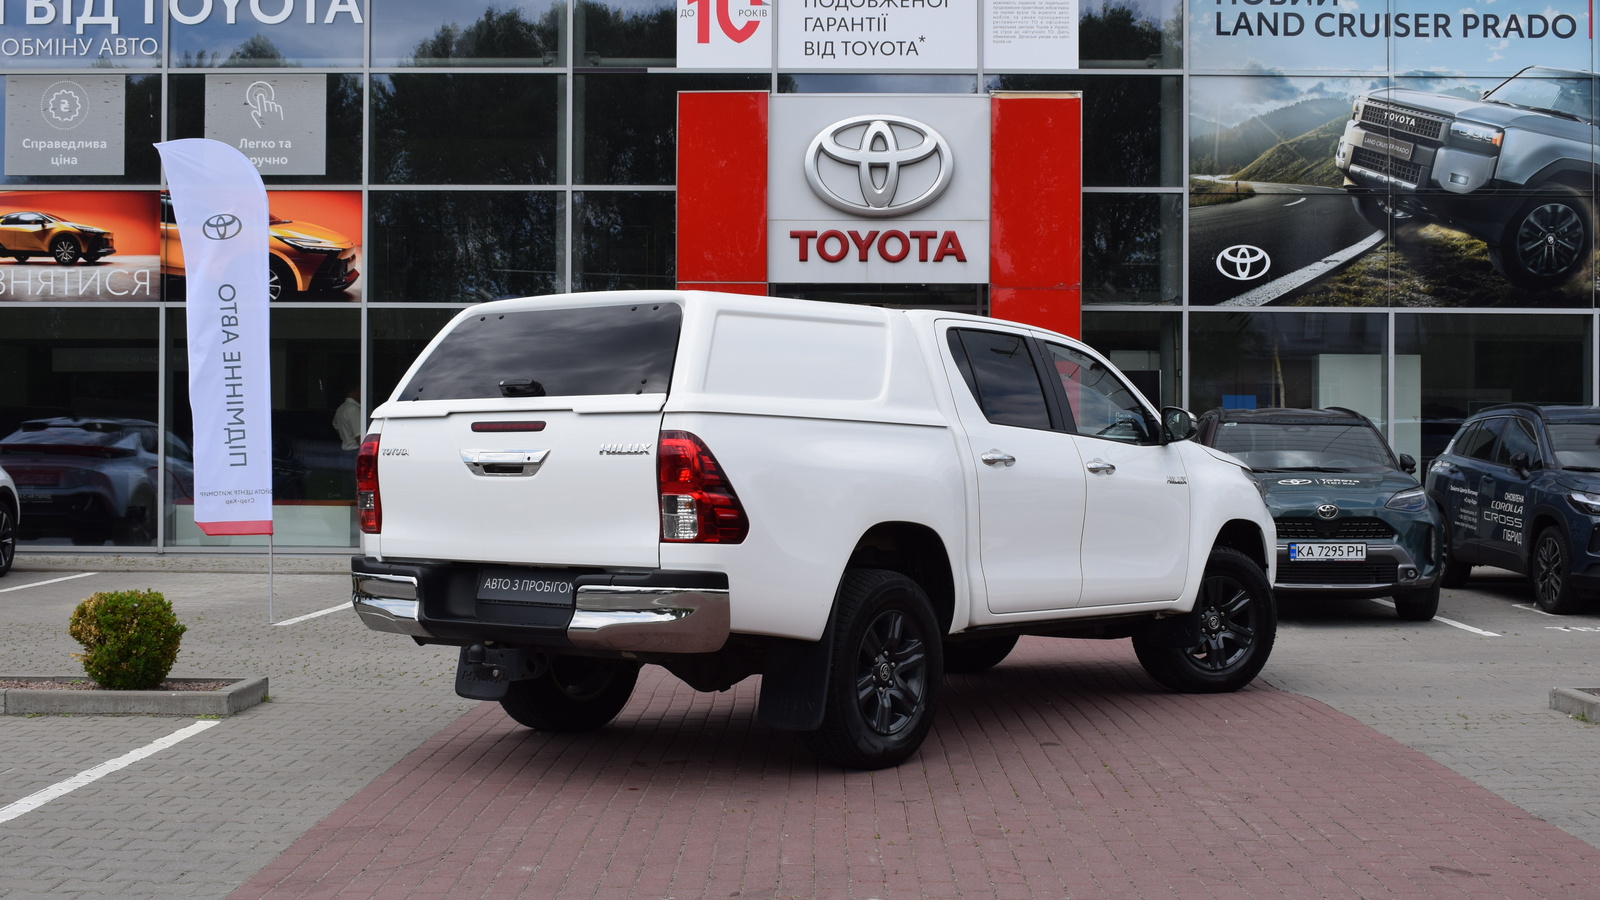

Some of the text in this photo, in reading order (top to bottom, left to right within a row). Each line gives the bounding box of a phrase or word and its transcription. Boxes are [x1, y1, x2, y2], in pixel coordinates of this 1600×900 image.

[680, 9, 695, 18] ДО
[738, 9, 768, 17] РОКІВ
[804, 14, 888, 32] ГАРАНТІЇ
[1215, 12, 1578, 39] LAND CRUISER PRADO
[2, 37, 158, 56] ОБМІНУ АВТО
[804, 41, 836, 59] ВІД
[1384, 112, 1415, 126] TOYOTA
[22, 138, 107, 151] Справедлива
[239, 138, 292, 149] Легко та
[1395, 145, 1409, 154] PRADO
[51, 154, 78, 166] ціна
[249, 156, 288, 168] ручно
[790, 229, 967, 263] TOYOTA
[599, 442, 653, 456] HILUX
[1490, 500, 1524, 515] COROLLA
[1483, 510, 1523, 528] CROSS
[1297, 545, 1364, 557] KA 7295 PH
[483, 578, 511, 590] АВТО
